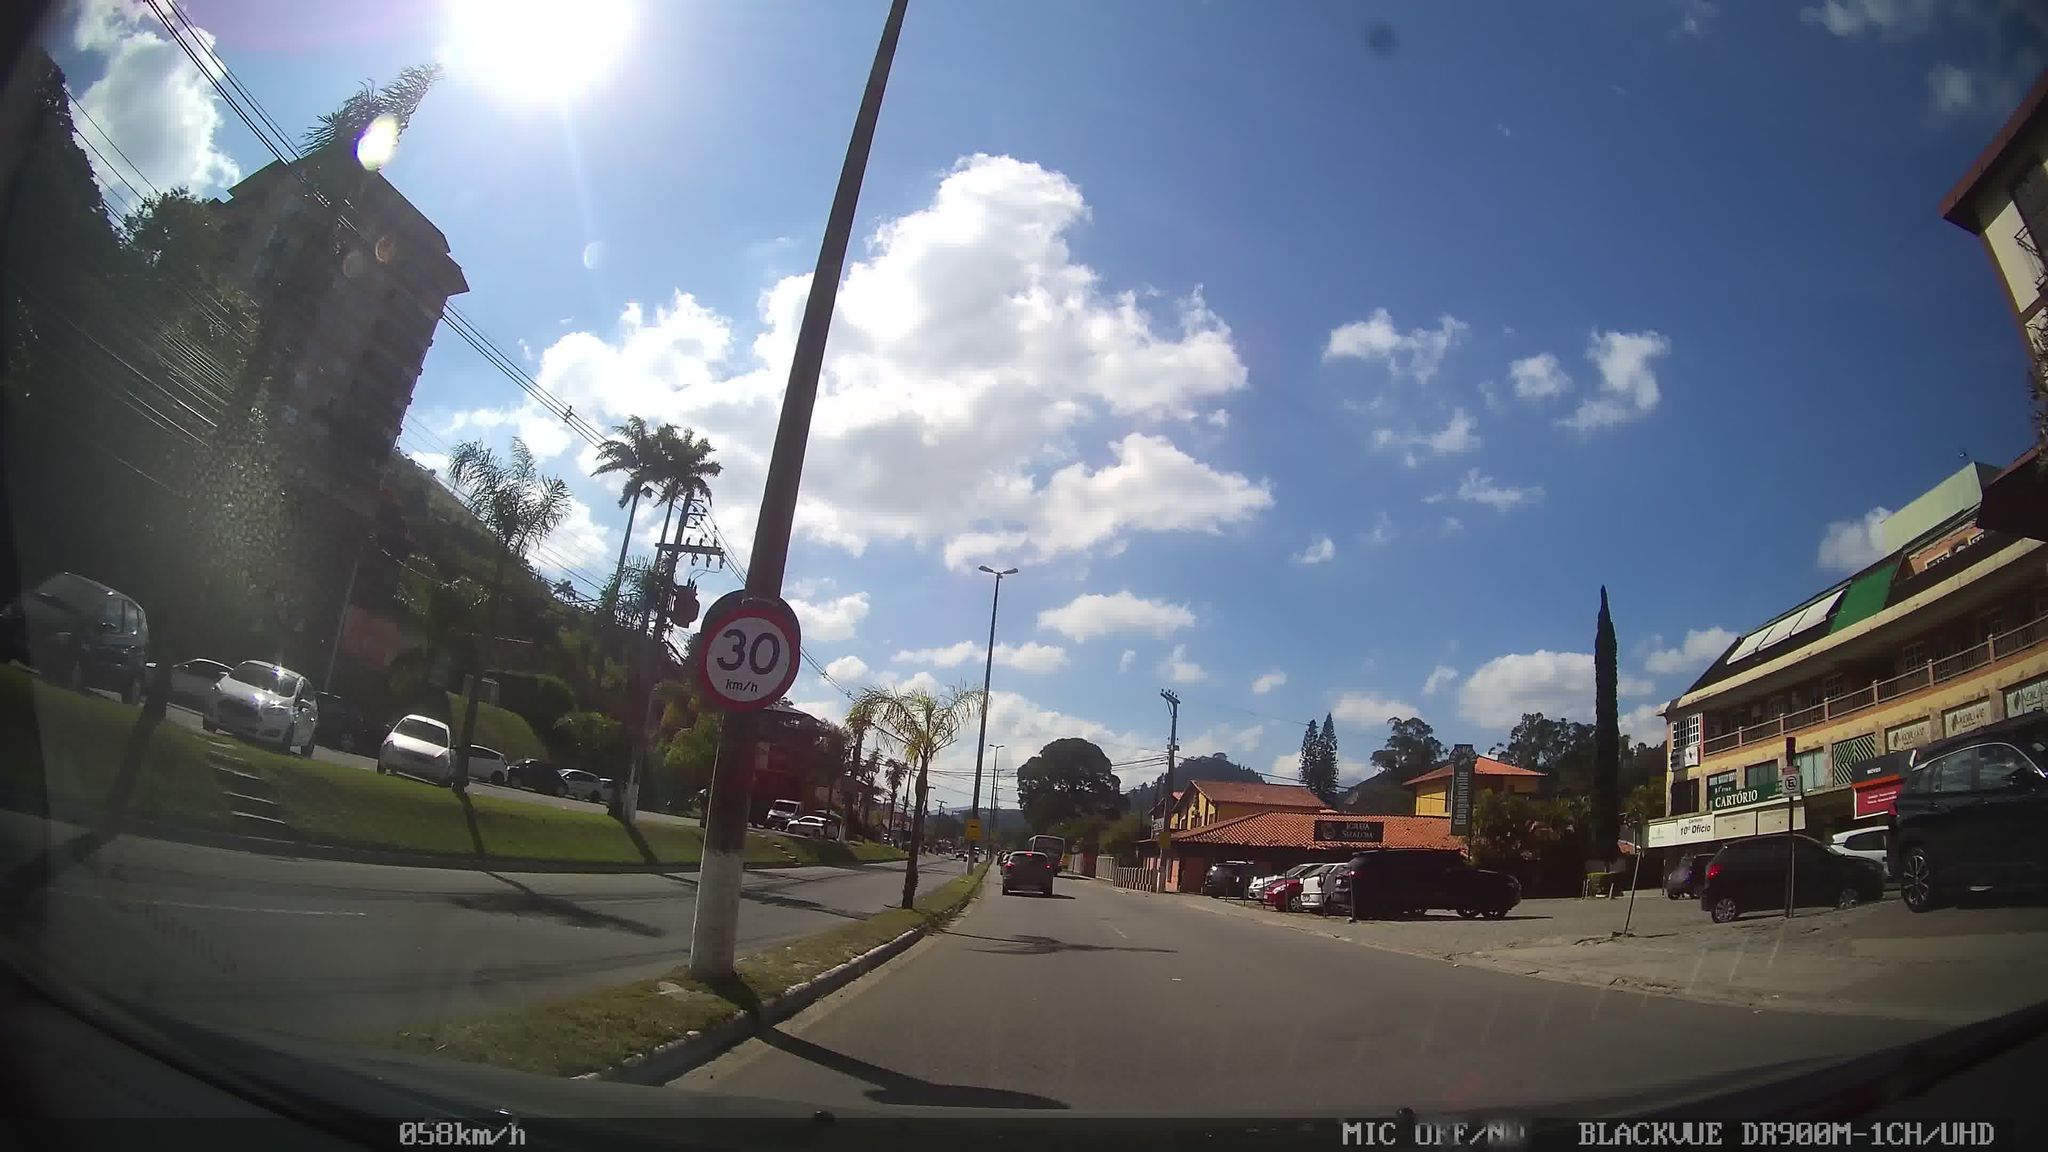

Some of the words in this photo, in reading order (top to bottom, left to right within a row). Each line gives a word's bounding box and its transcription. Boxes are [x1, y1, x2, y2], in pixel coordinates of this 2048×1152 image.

[716, 629, 781, 675] 30
[725, 679, 758, 692] km/h
[1715, 789, 1758, 808] CARTÓRIO
